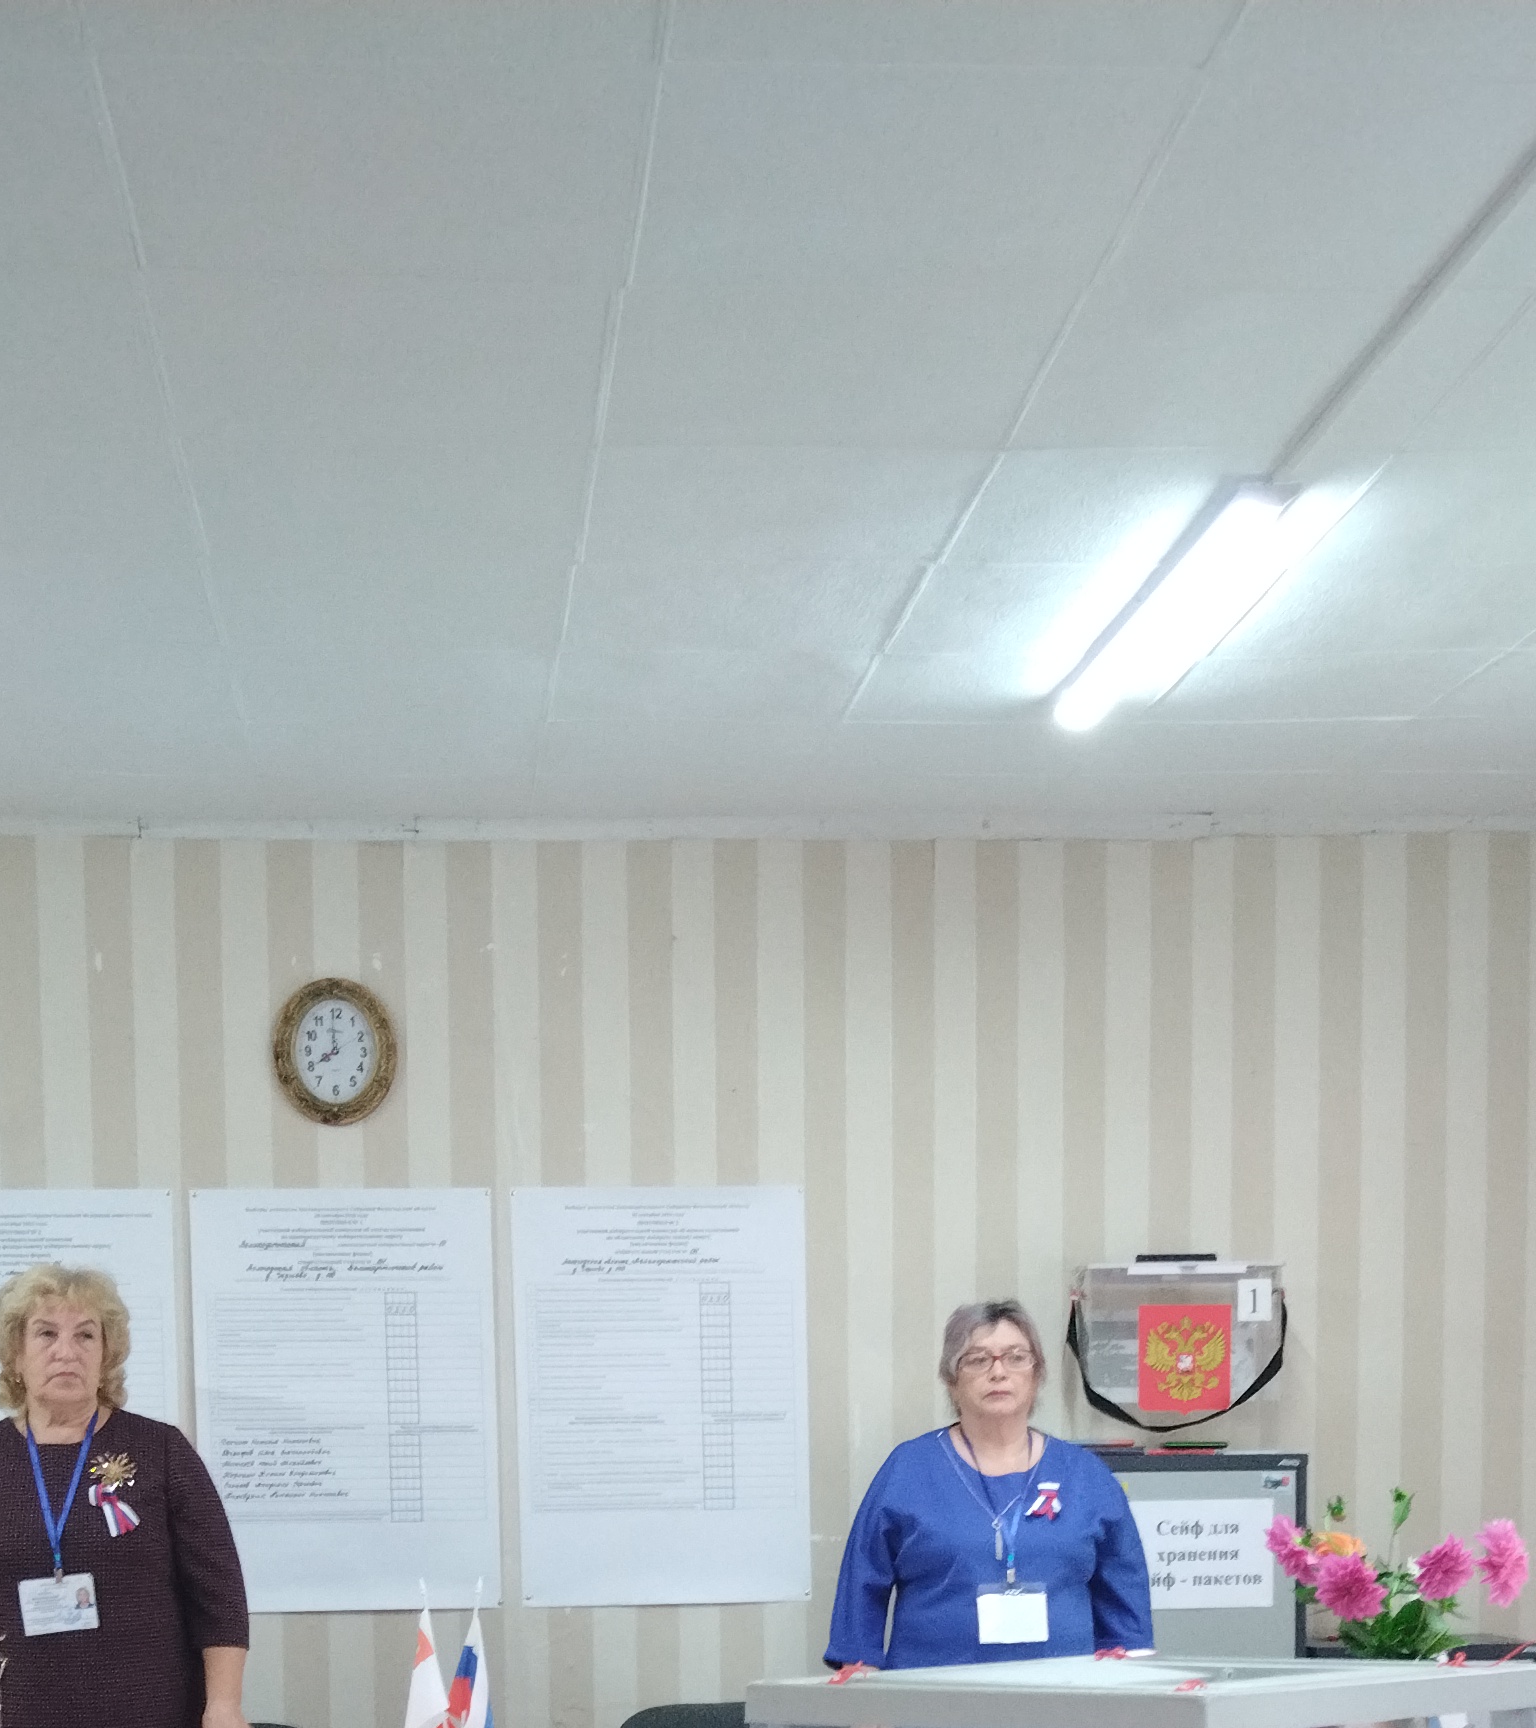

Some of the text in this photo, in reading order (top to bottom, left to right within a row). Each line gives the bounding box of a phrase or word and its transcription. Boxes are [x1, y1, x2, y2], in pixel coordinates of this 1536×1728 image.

[330, 1008, 342, 1020] 12
[314, 1015, 323, 1027] 11
[350, 1016, 355, 1028] 1
[306, 1030, 317, 1041] 10
[357, 1031, 364, 1042] 2
[304, 1045, 312, 1057] 9
[360, 1047, 367, 1058] 3
[307, 1061, 315, 1072] 8
[356, 1061, 364, 1073] 4
[315, 1075, 322, 1087] 7
[349, 1075, 357, 1087] 5
[332, 1085, 340, 1096] 6
[1249, 1288, 1257, 1313] 1
[1156, 1520, 1240, 1539] Сейф для
[1157, 1549, 1240, 1566] хранения
[1150, 1571, 1176, 1591] йф
[1192, 1574, 1263, 1587] пакетов
